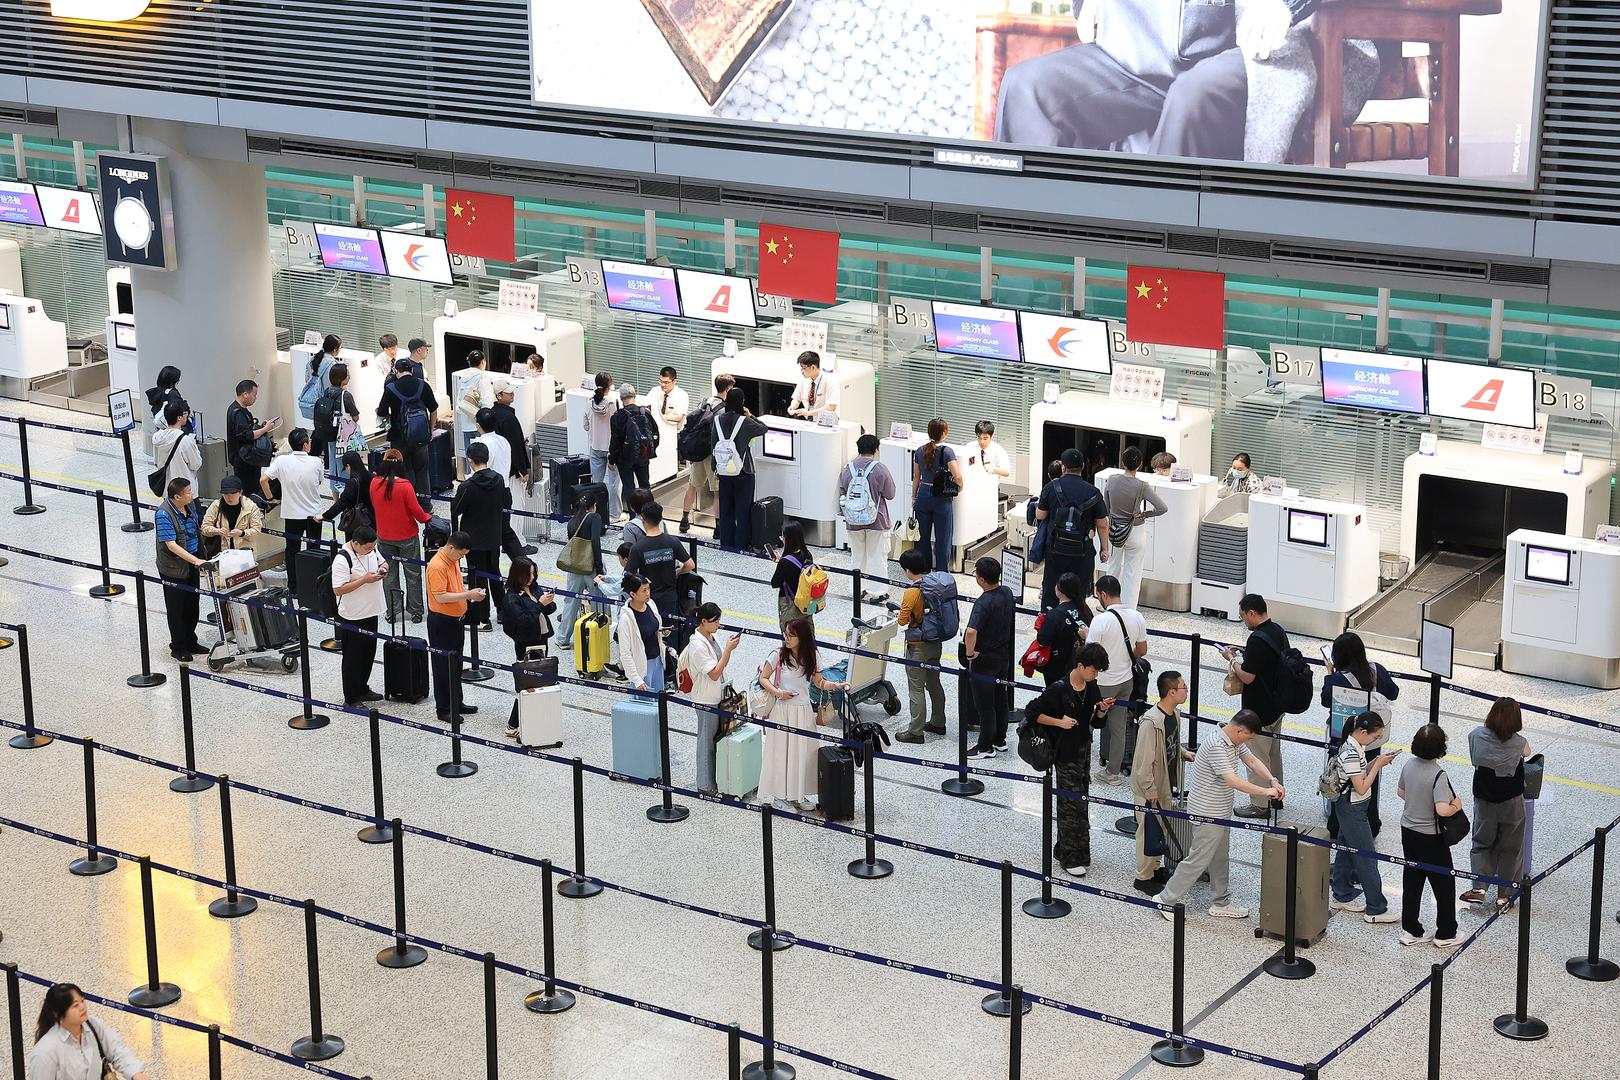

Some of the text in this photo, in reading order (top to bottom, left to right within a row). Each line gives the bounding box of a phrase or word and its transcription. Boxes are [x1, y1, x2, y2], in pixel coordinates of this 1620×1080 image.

[109, 168, 149, 180] LONGINES
[286, 226, 314, 248] B11
[338, 241, 362, 253] 经济舱
[336, 252, 356, 260] ECONOMY
[568, 263, 600, 286] B13
[627, 279, 654, 292] 经济舱
[624, 291, 646, 299] ECONOMY
[894, 303, 929, 328] B15
[960, 322, 992, 336] 经济舱
[956, 335, 982, 343] ECONOMY
[1112, 331, 1150, 357] B16
[1274, 351, 1314, 377] B17
[1354, 370, 1392, 385] 经济舱
[1347, 385, 1400, 396] ECONOMY CLASS
[1540, 382, 1585, 411] B18
